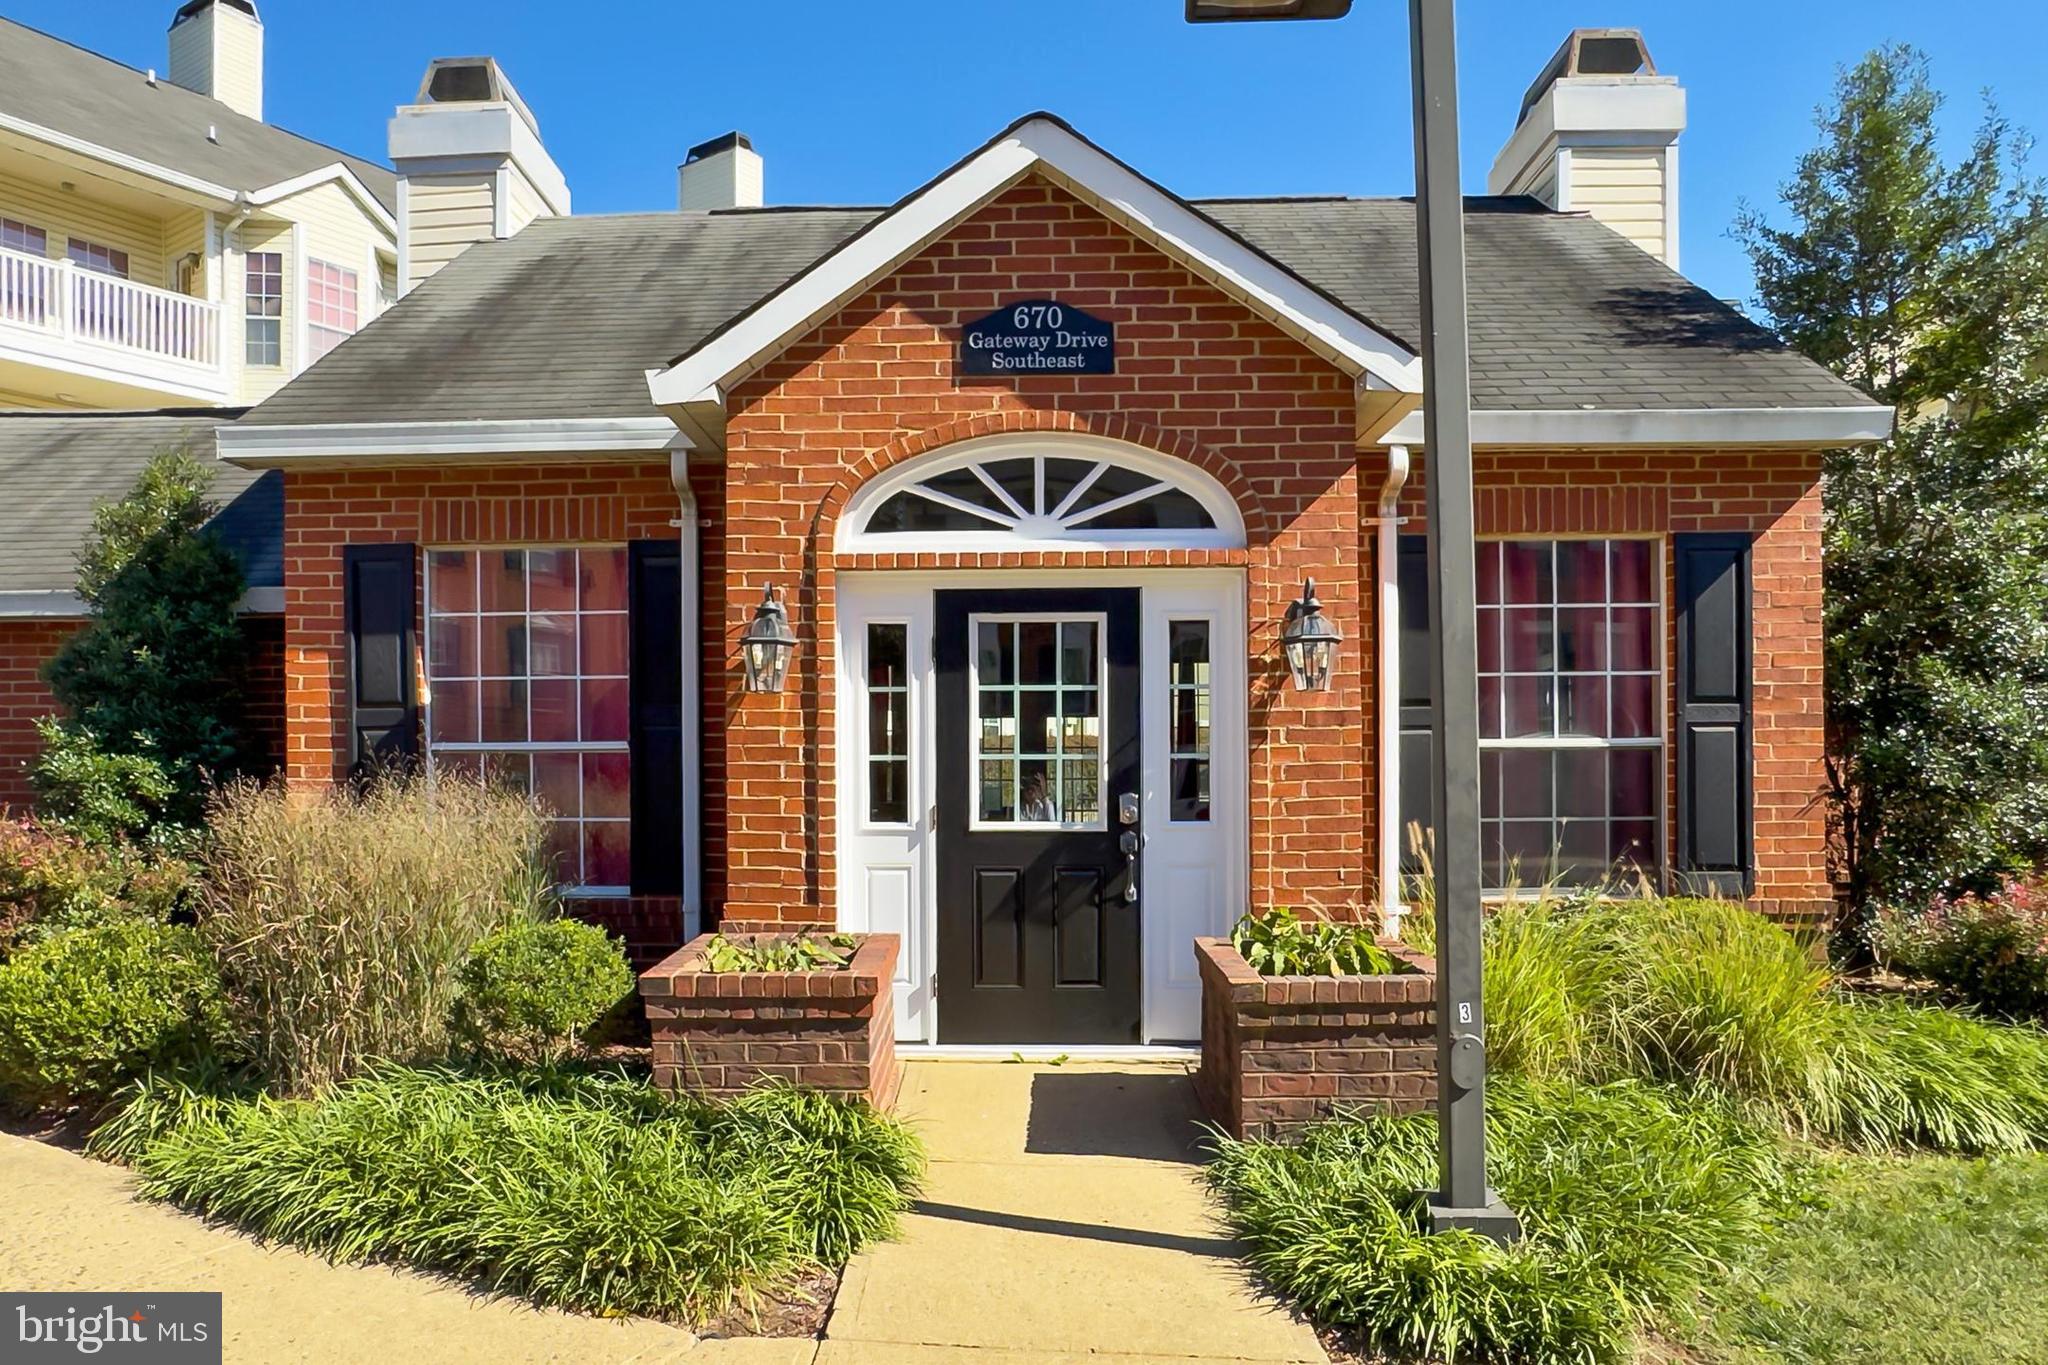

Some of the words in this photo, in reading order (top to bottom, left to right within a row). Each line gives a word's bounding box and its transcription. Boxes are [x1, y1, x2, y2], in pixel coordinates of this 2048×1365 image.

[1013, 306, 1063, 329] 670
[968, 331, 1051, 352] Gateway
[1055, 331, 1108, 348] Drive
[992, 352, 1086, 369] Southeast
[1461, 1004, 1470, 1021] 3
